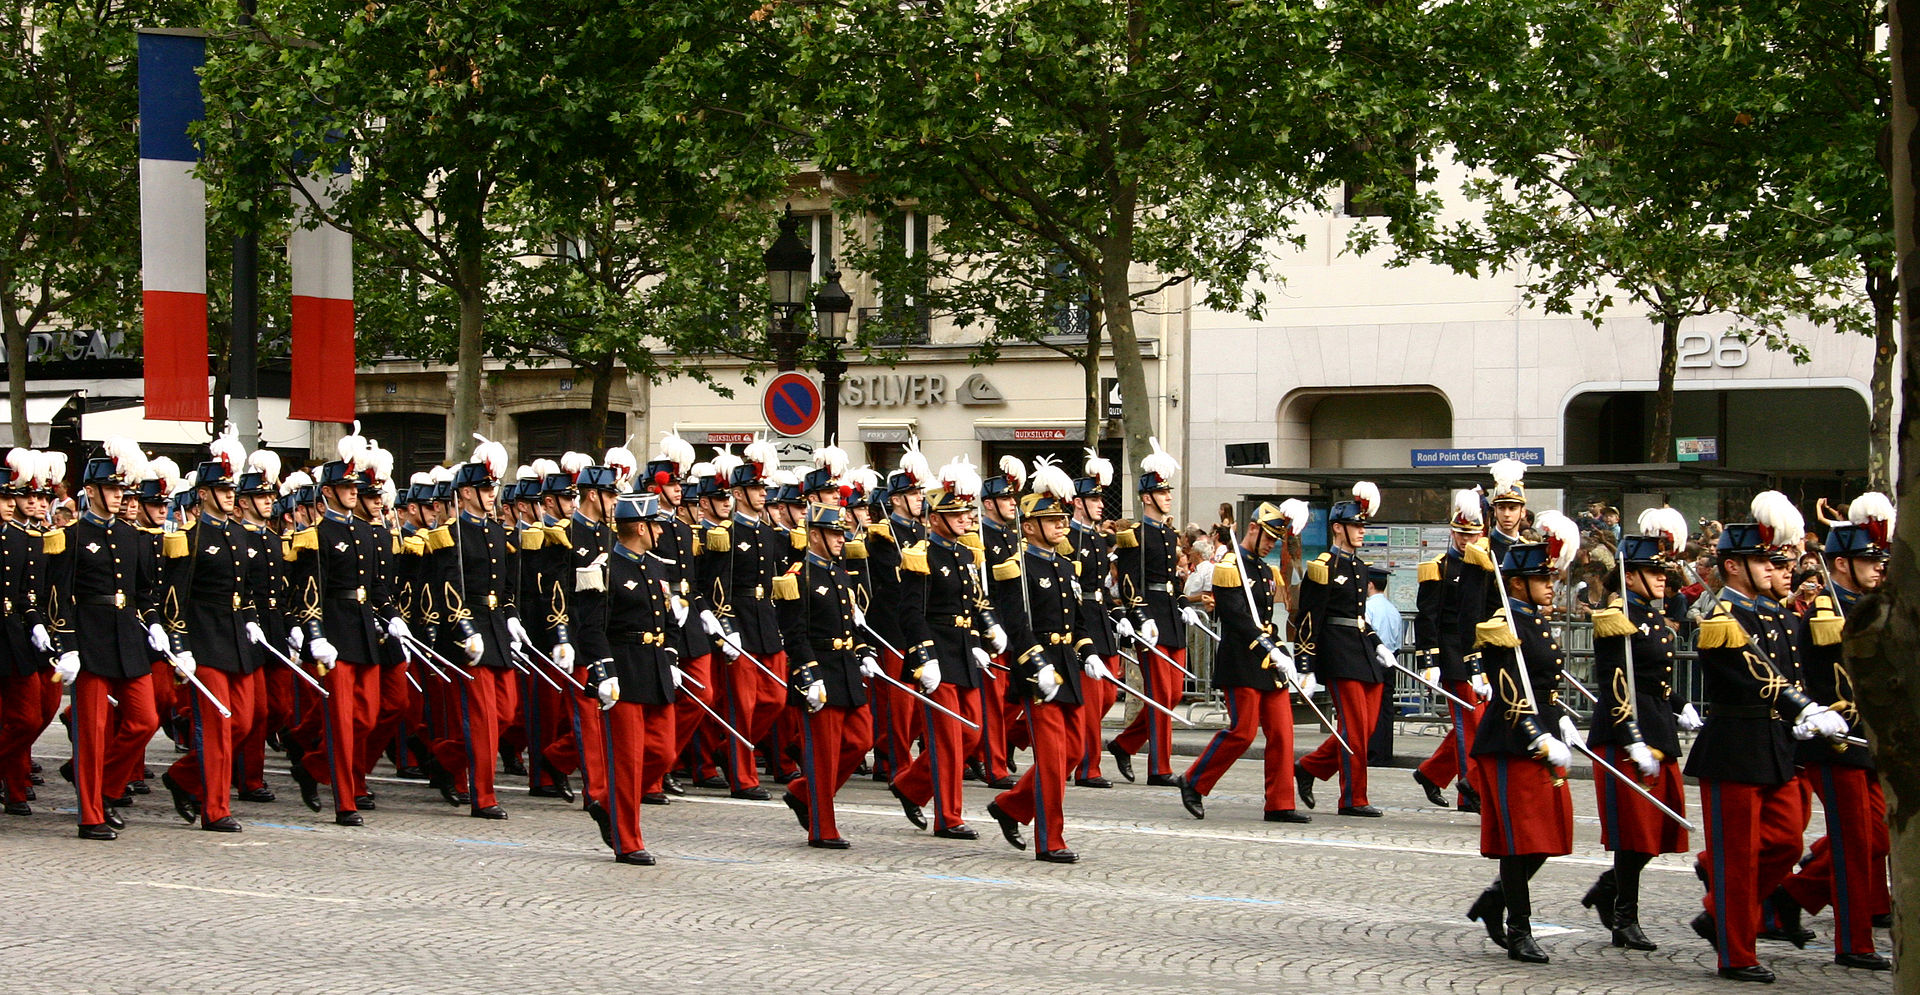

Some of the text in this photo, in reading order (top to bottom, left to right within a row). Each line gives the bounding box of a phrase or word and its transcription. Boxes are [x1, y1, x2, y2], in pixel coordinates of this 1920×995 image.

[1679, 331, 1748, 368] 26
[867, 432, 887, 440] roxy
[1015, 430, 1054, 439] QUIKSILVER
[1417, 450, 1539, 462] Rond Point des Champs Elysées
